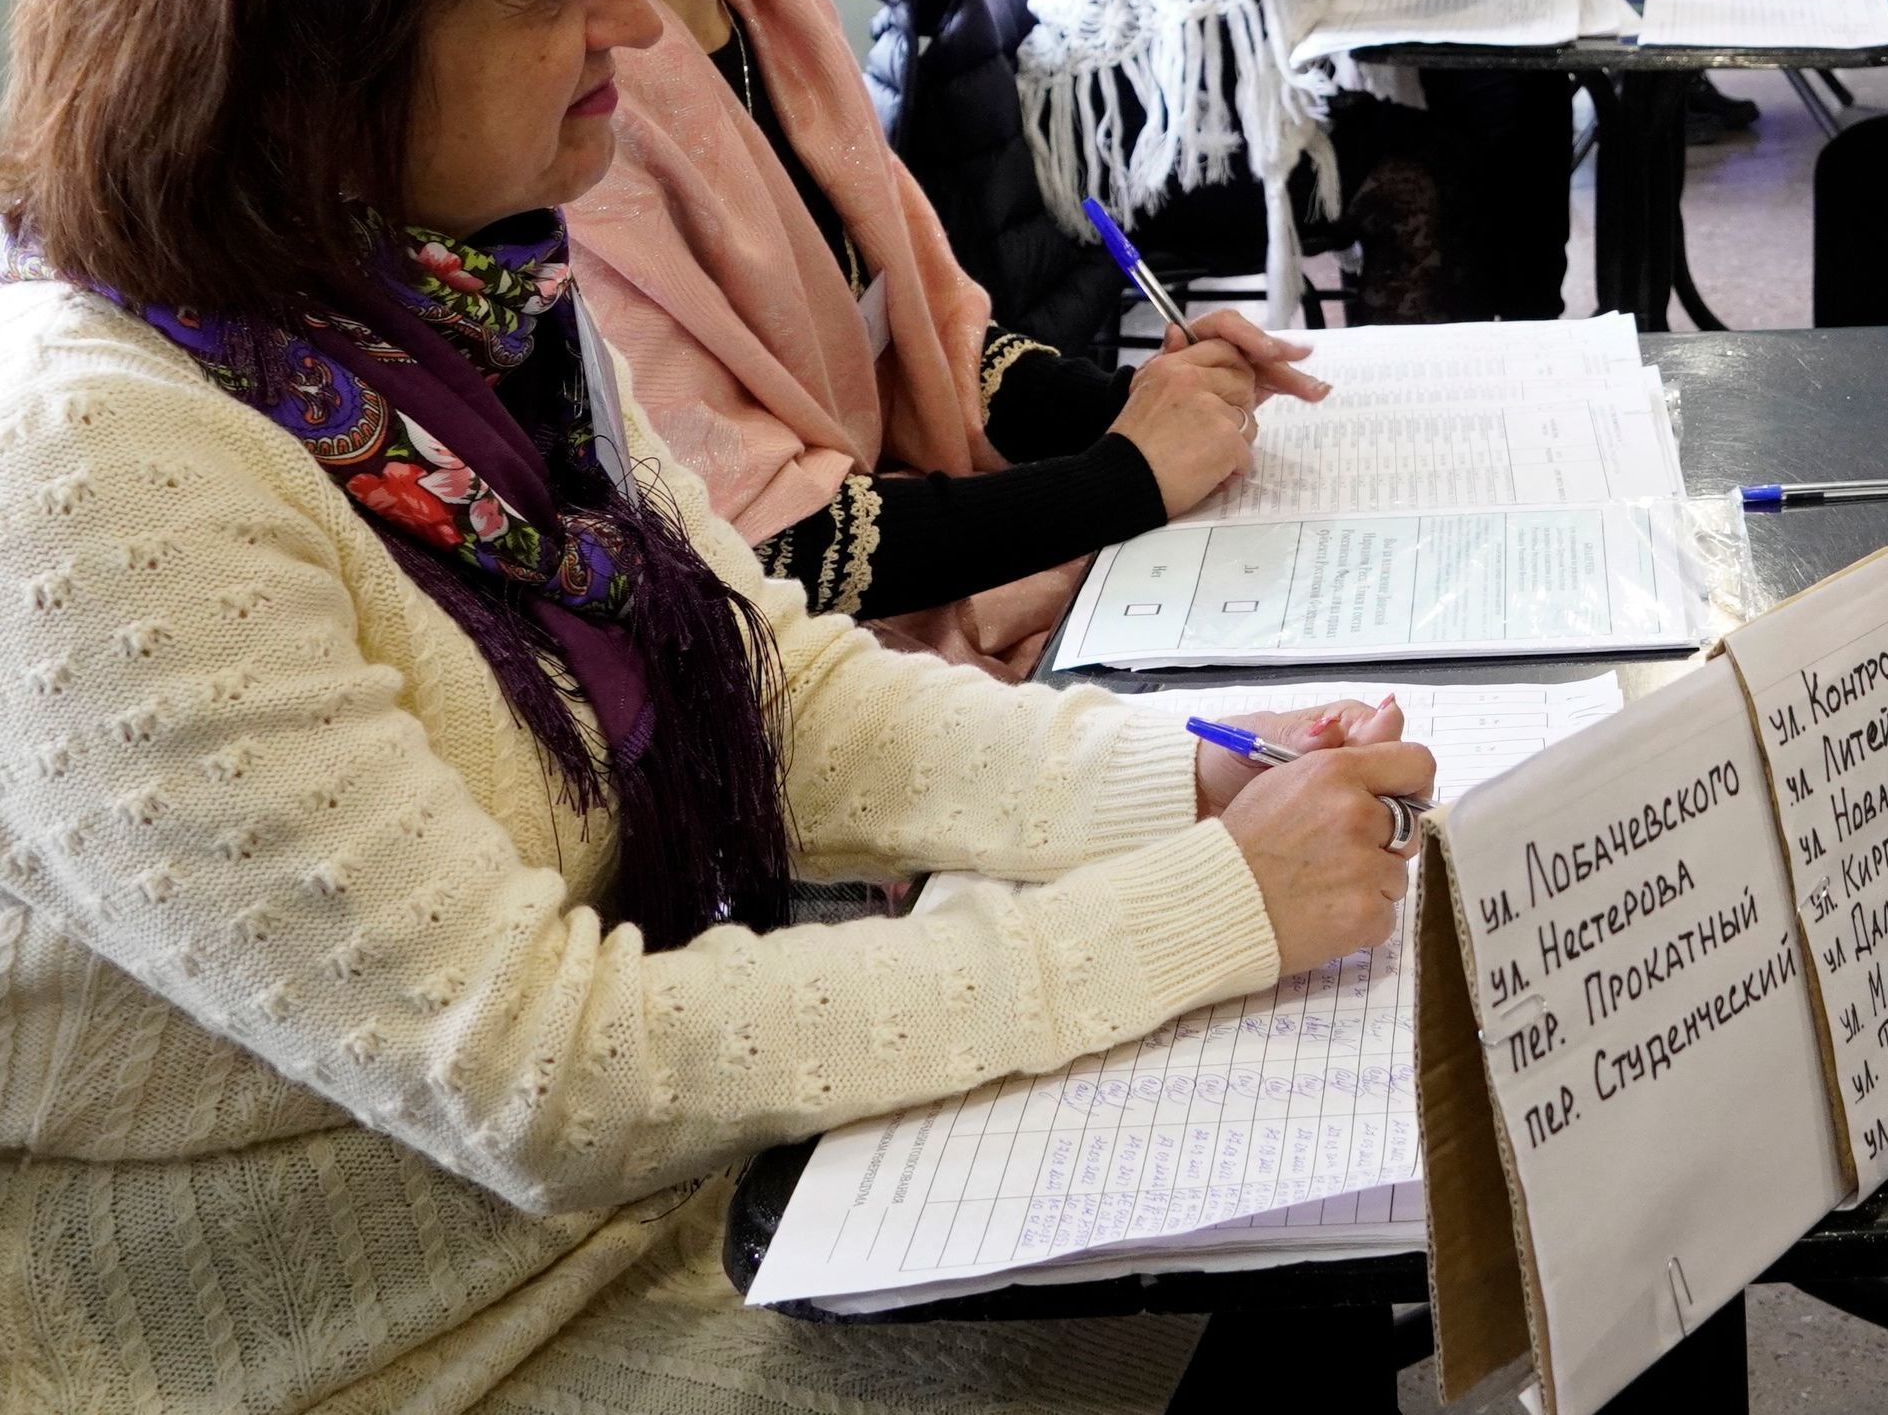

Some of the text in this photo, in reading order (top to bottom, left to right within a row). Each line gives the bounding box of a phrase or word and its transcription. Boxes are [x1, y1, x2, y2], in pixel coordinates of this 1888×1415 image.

[1769, 705, 1807, 746] ул.
[1480, 890, 1520, 934] ул.
[1491, 960, 1530, 1008] ул.
[1840, 1002, 1865, 1044] ул.
[1852, 1059, 1879, 1104] ул.
